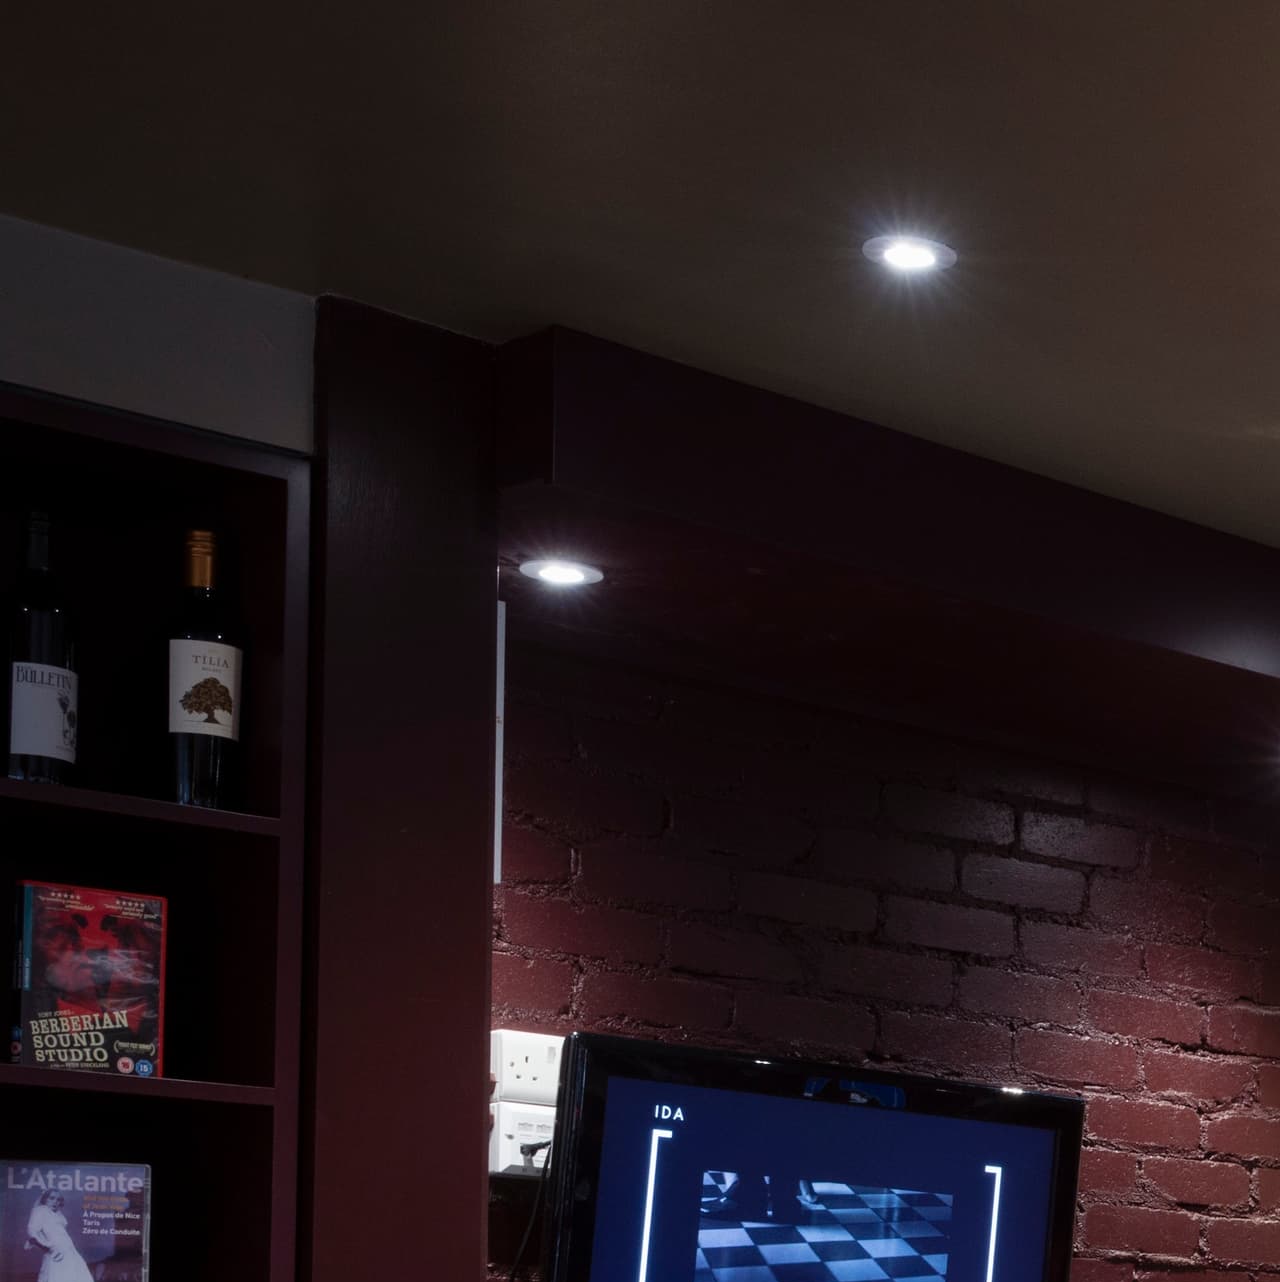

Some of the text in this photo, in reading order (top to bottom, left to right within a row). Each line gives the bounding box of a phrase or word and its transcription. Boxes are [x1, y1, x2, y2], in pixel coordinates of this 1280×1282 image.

[192, 653, 230, 669] TILIA
[29, 1010, 129, 1035] BERBERIAN
[32, 1031, 105, 1049] SOUND
[35, 1048, 109, 1062] STUDIO
[140, 1064, 148, 1072] 15
[654, 1104, 684, 1121] IDA
[7, 1166, 144, 1193] L'Atalante
